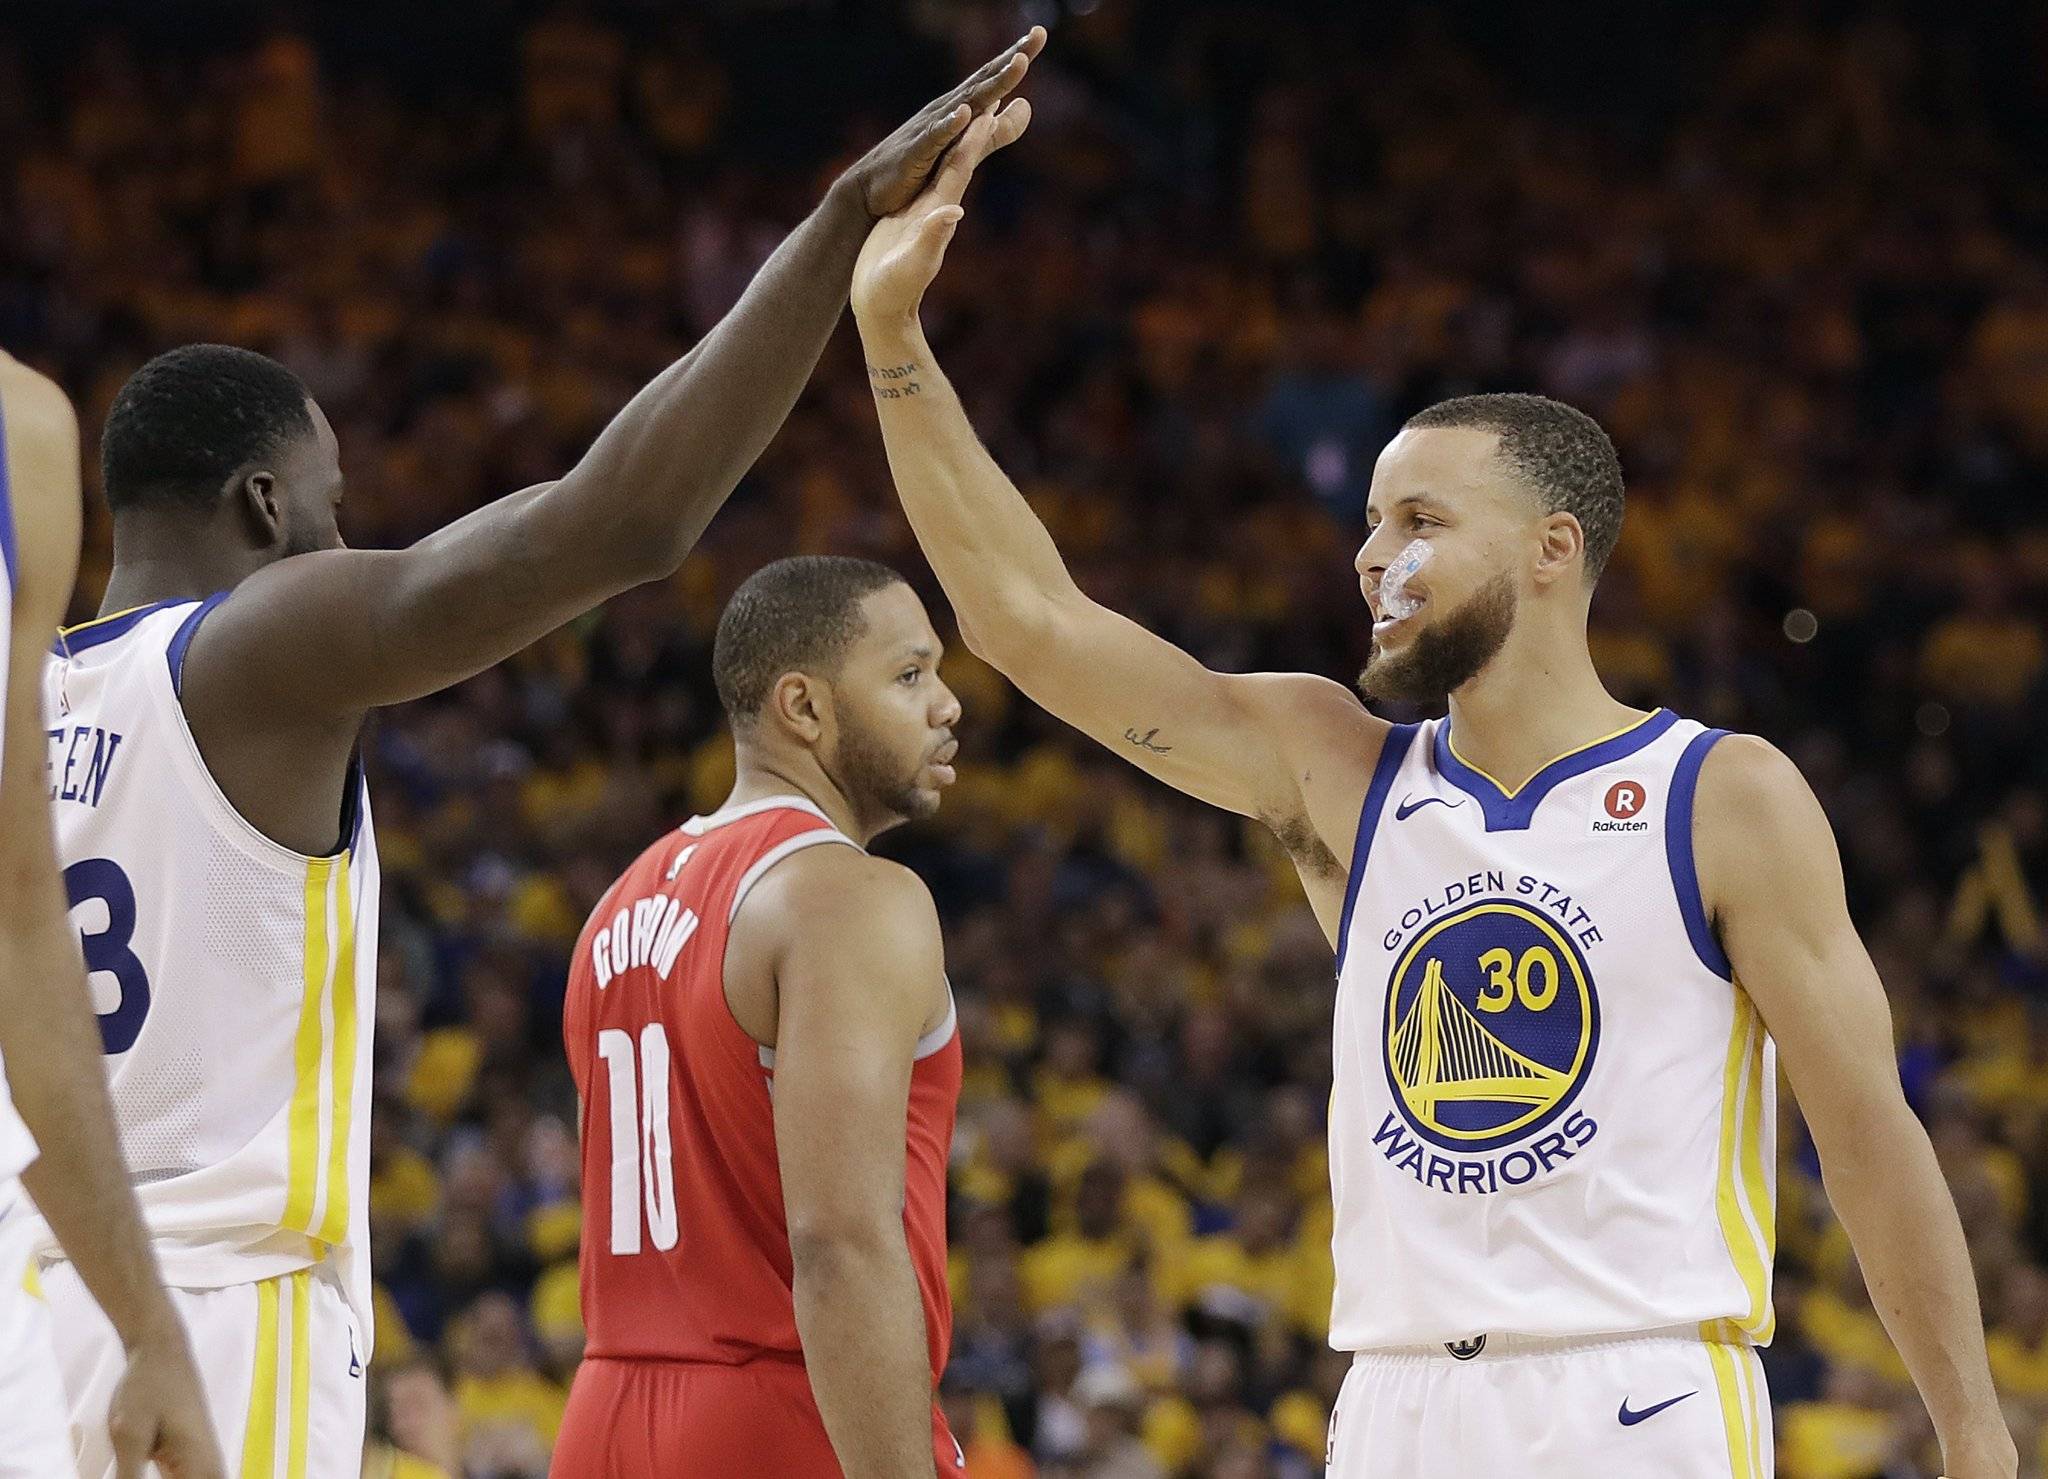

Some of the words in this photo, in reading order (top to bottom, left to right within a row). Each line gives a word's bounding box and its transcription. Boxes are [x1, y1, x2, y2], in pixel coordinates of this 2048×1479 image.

[1592, 821, 1648, 831] Rakuten
[1383, 871, 1505, 952] GOLDEN
[1516, 875, 1604, 951] STATE
[1476, 945, 1561, 1013] 30
[598, 1022, 680, 1256] 10
[1371, 1109, 1599, 1195] WARRIORS
